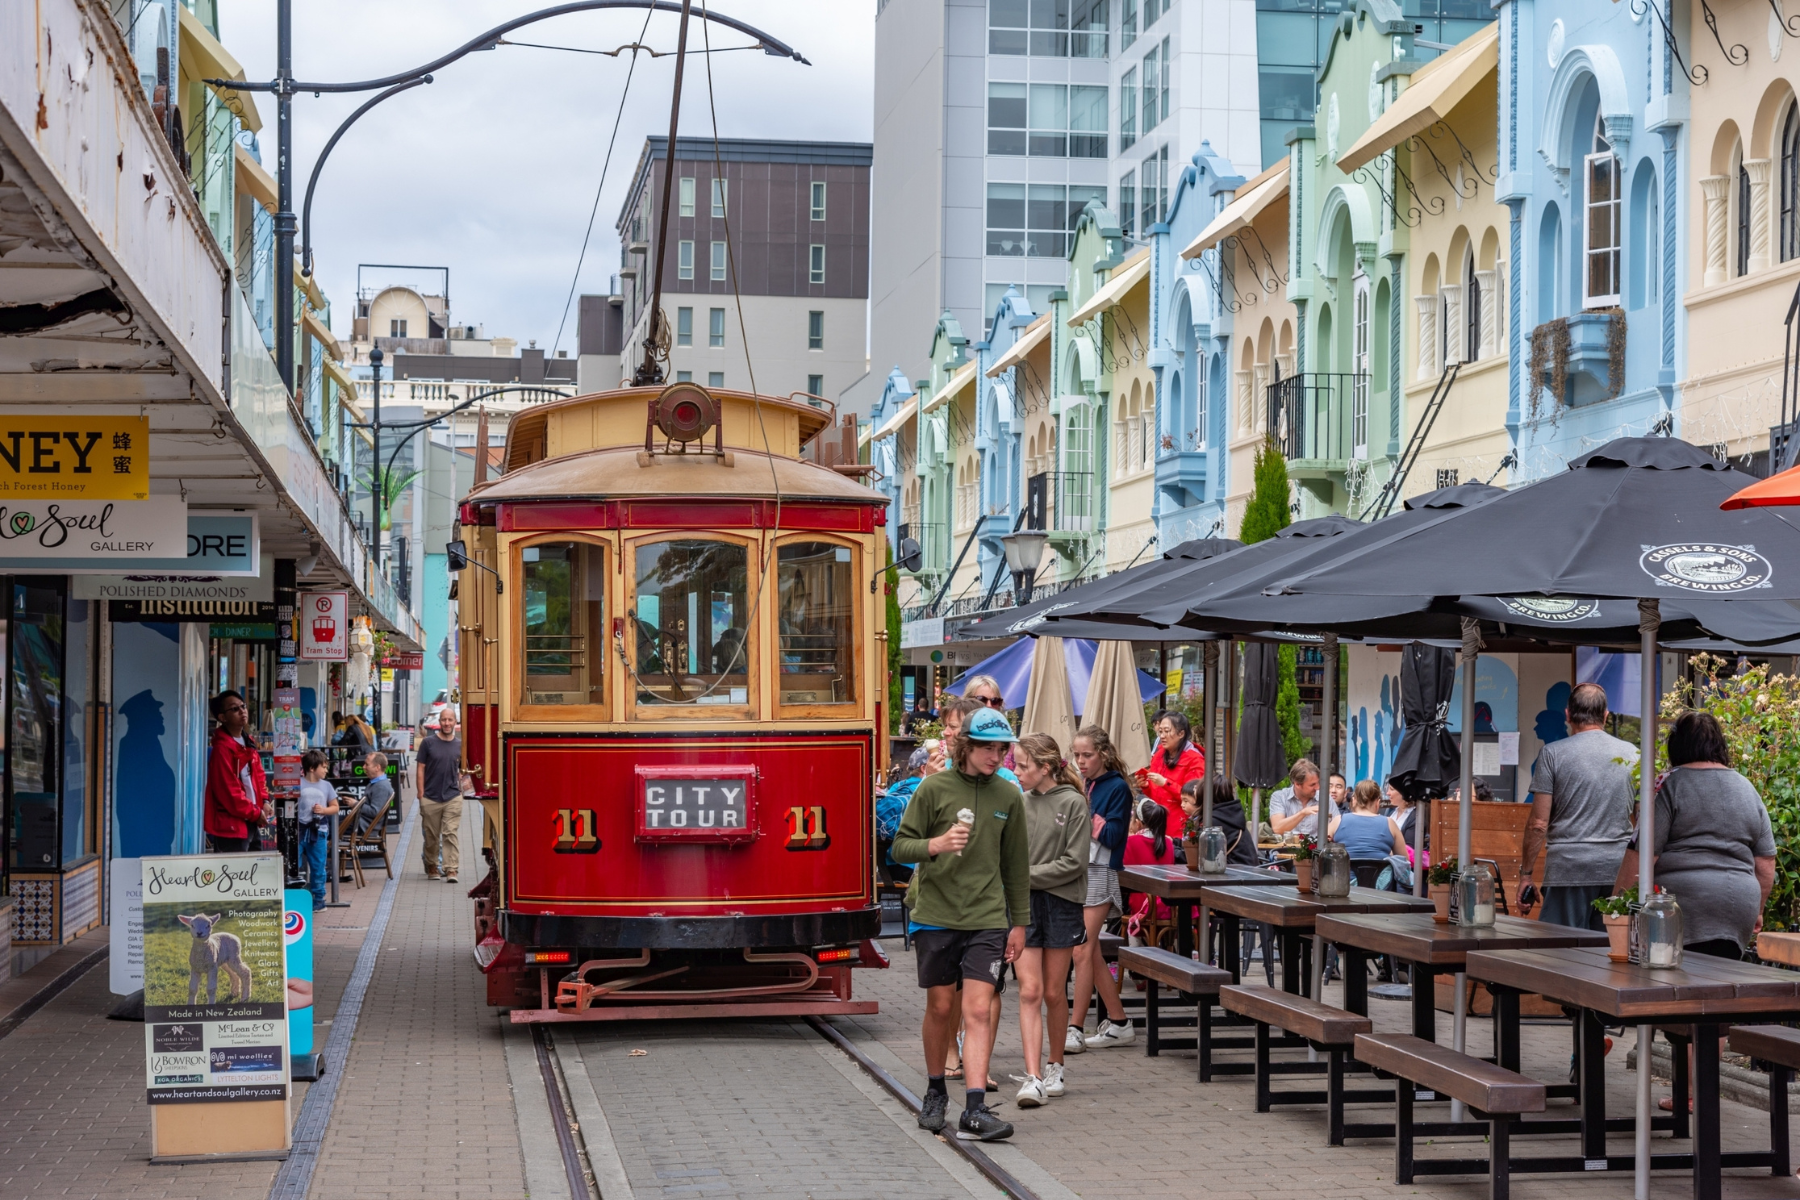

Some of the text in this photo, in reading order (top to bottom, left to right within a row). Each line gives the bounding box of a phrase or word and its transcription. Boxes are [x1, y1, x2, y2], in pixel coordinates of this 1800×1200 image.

[14, 482, 47, 491] Forest
[51, 482, 86, 493] Honey
[38, 503, 114, 548] Soul
[90, 541, 154, 551] GALLERY
[1648, 545, 1702, 563] CASSELS
[1718, 547, 1757, 563] SONS
[1659, 573, 1743, 591] BREWING
[99, 585, 166, 598] POLISHED
[1509, 602, 1577, 620] BREWING
[326, 647, 342, 655] Stop
[646, 787, 741, 805] CITY
[646, 809, 738, 827] TOUR
[553, 808, 598, 849] 11
[786, 806, 828, 846] 11
[149, 863, 259, 895] Heart Soul
[233, 888, 278, 897] GALLERY
[228, 909, 278, 919] Photography
[238, 919, 278, 927] Woodwork
[243, 929, 278, 938] Ceramics
[244, 940, 278, 949] Jewellery
[244, 949, 279, 957] Knitwear
[260, 969, 279, 977] Gifts
[168, 1007, 262, 1018] Made in New Zealand
[251, 1023, 261, 1032] &
[162, 1056, 206, 1066] BOWRON
[217, 1073, 279, 1083] LYTTELTON LIGHTS
[152, 1087, 282, 1100] www.heartandsoulgallery.co.nz
